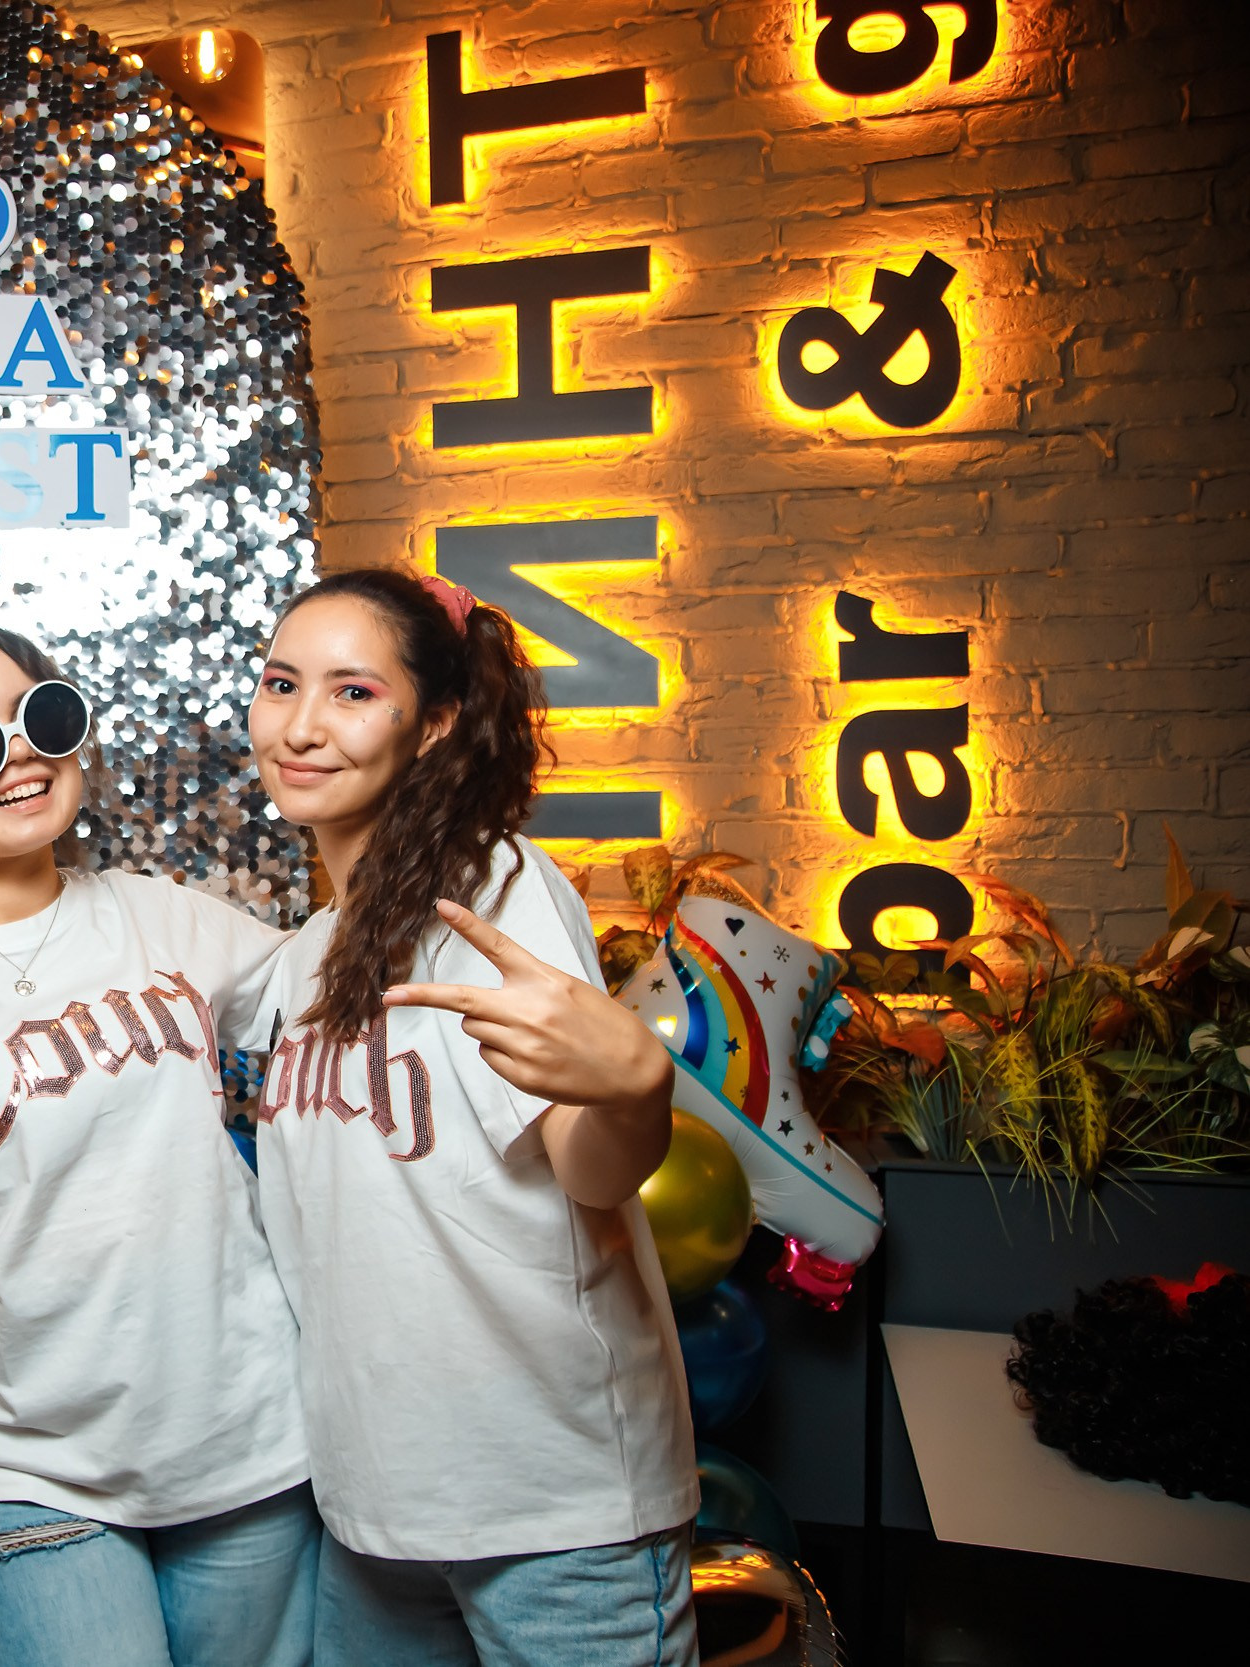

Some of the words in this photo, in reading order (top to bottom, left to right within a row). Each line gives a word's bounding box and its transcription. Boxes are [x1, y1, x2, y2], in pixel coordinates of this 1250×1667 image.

[427, 31, 662, 839] ИНТ
[778, 250, 961, 429] &
[820, 590, 974, 995] bar
[258, 1005, 436, 1163] ouch
